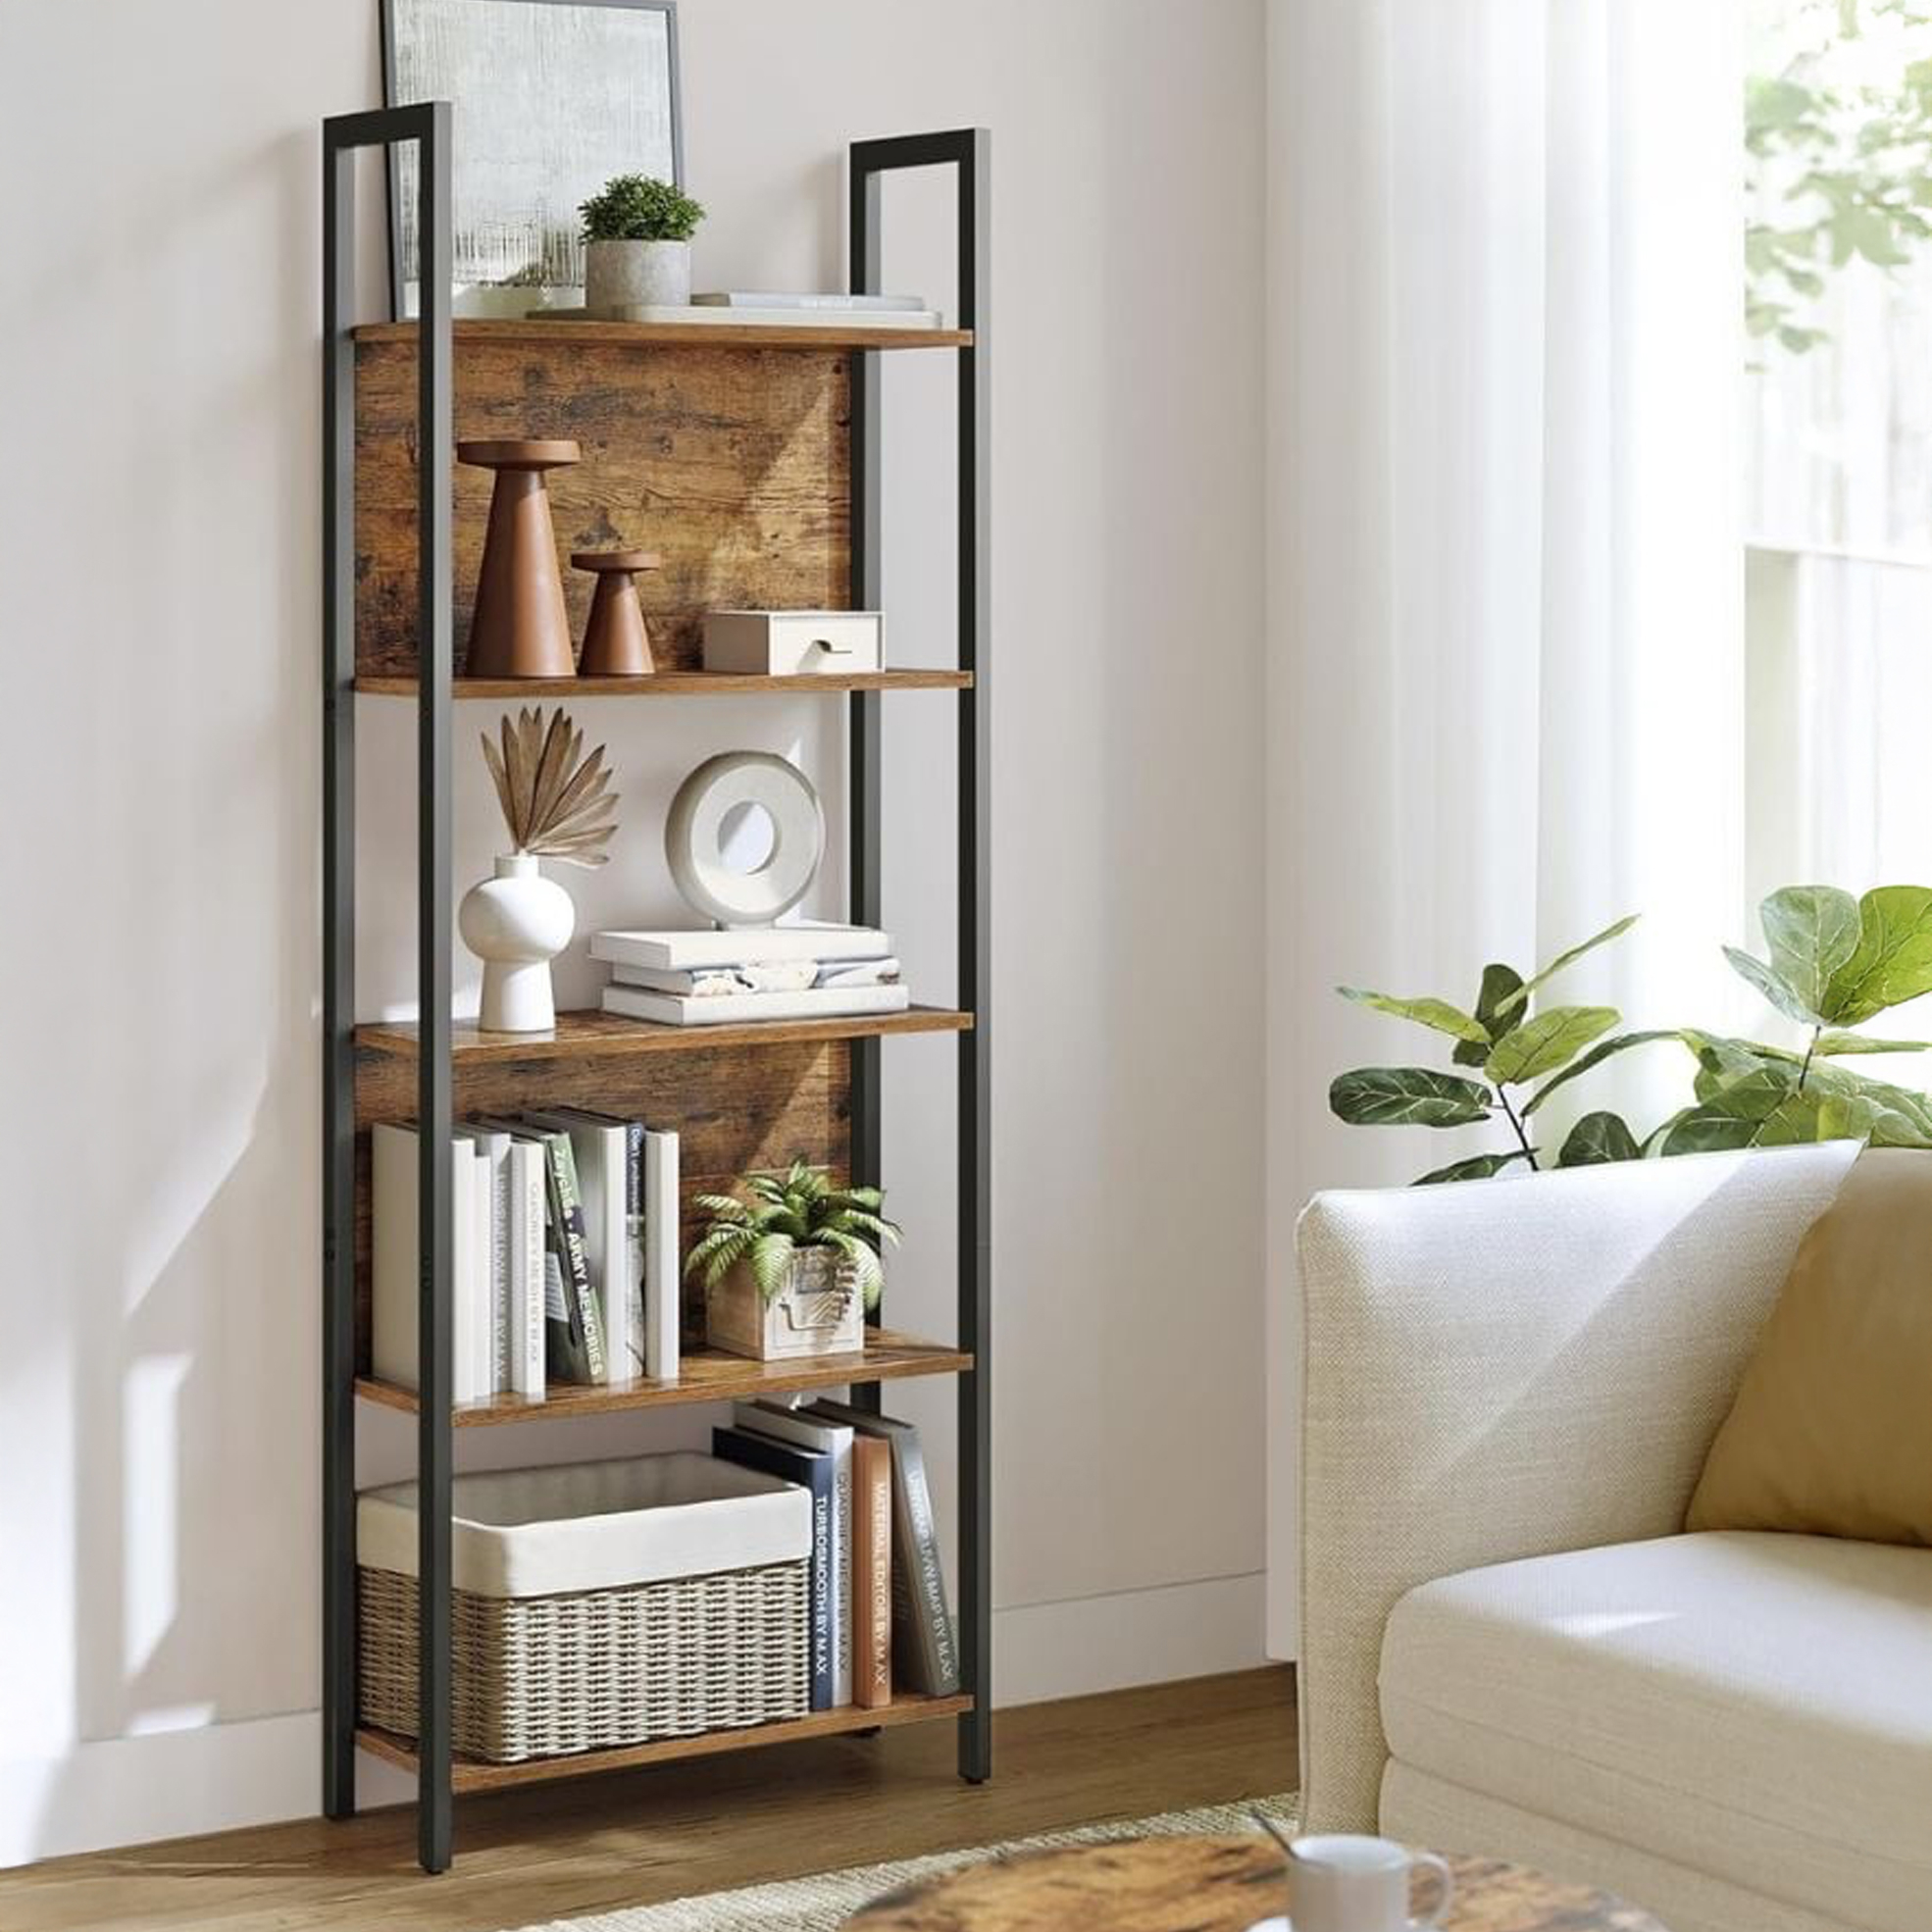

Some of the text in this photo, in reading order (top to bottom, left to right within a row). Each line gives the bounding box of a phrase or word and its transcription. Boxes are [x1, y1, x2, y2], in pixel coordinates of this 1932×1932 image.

[568, 1232, 587, 1280] ARMY
[577, 1283, 603, 1375] MEMORIES
[816, 1496, 828, 1611] TURBOSMOOTH
[873, 1559, 886, 1617] EDITOR
[816, 1614, 828, 1635] BY
[874, 1621, 886, 1641] BY
[933, 1617, 946, 1637] BY
